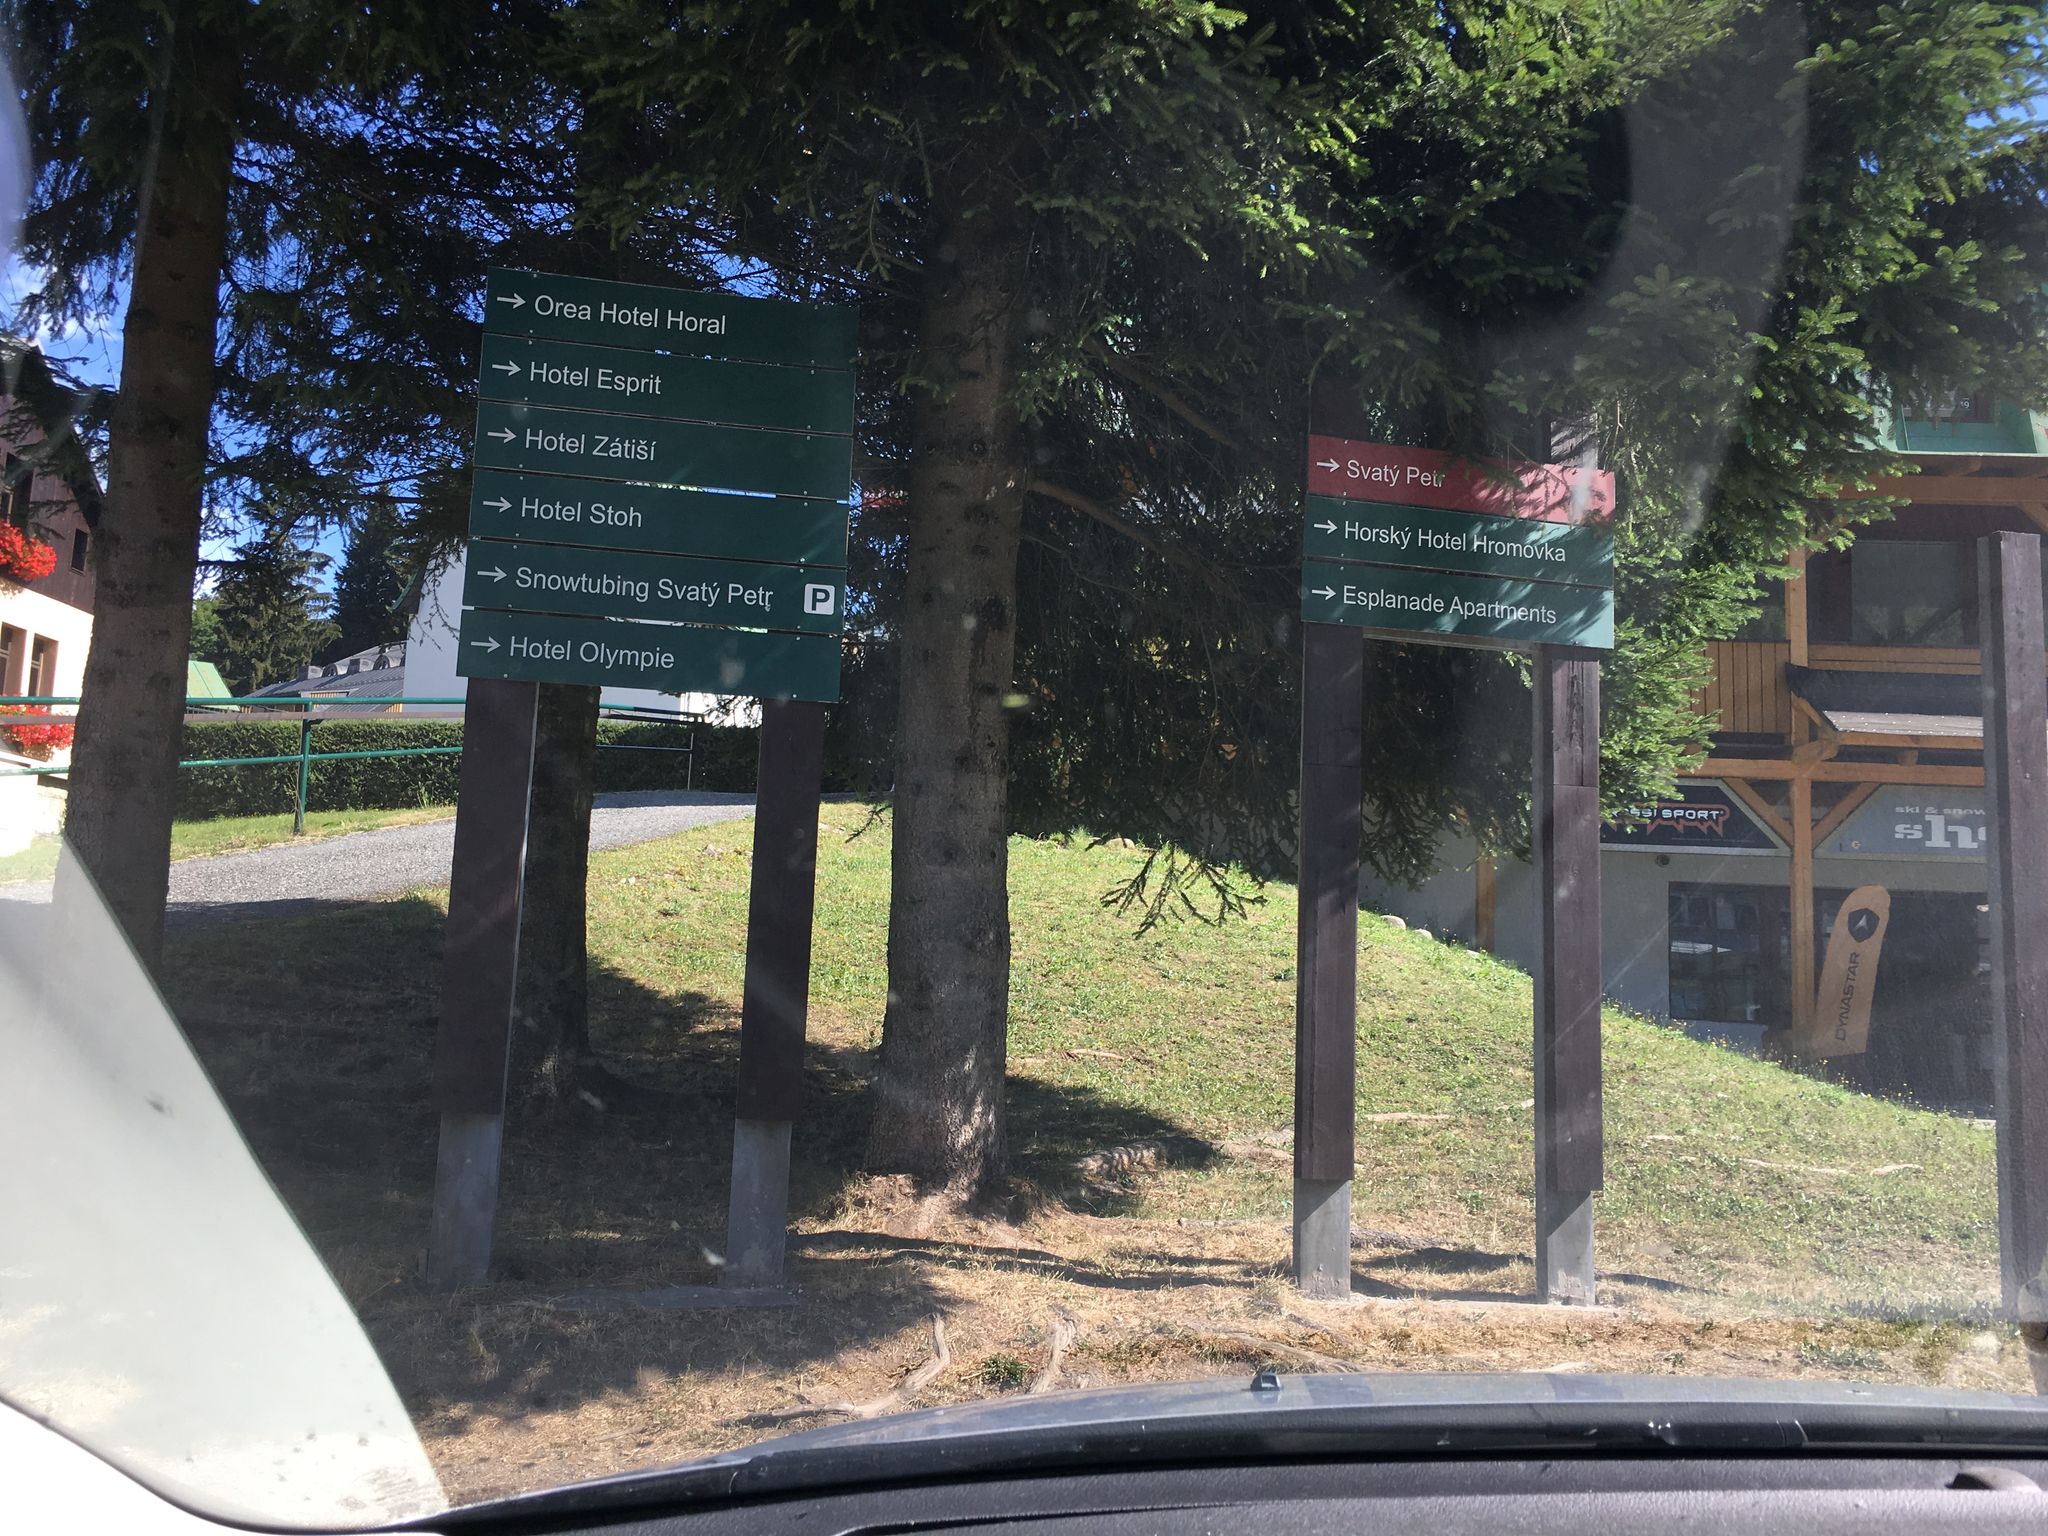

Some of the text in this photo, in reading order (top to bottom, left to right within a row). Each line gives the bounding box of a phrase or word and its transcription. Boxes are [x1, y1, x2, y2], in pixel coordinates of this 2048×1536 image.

[534, 294, 727, 335] Orea Hotel Horal
[530, 361, 662, 397] Hotel Esprit
[525, 428, 657, 461] Hotel Zátiší
[1346, 459, 1400, 487] Svatý
[521, 496, 643, 528] Hotel Stoh
[1345, 520, 1567, 562] Horský Hotel Hromovka
[515, 566, 774, 608] Snowtubing Svatý Petr
[811, 587, 831, 611] P
[1343, 585, 1557, 624] Esplanade Apartments
[510, 635, 676, 671] Hotel Olympie
[1661, 808, 1720, 820] SPORT
[1895, 806, 1920, 814] ski
[1834, 951, 1861, 1041] DYNASTAR
